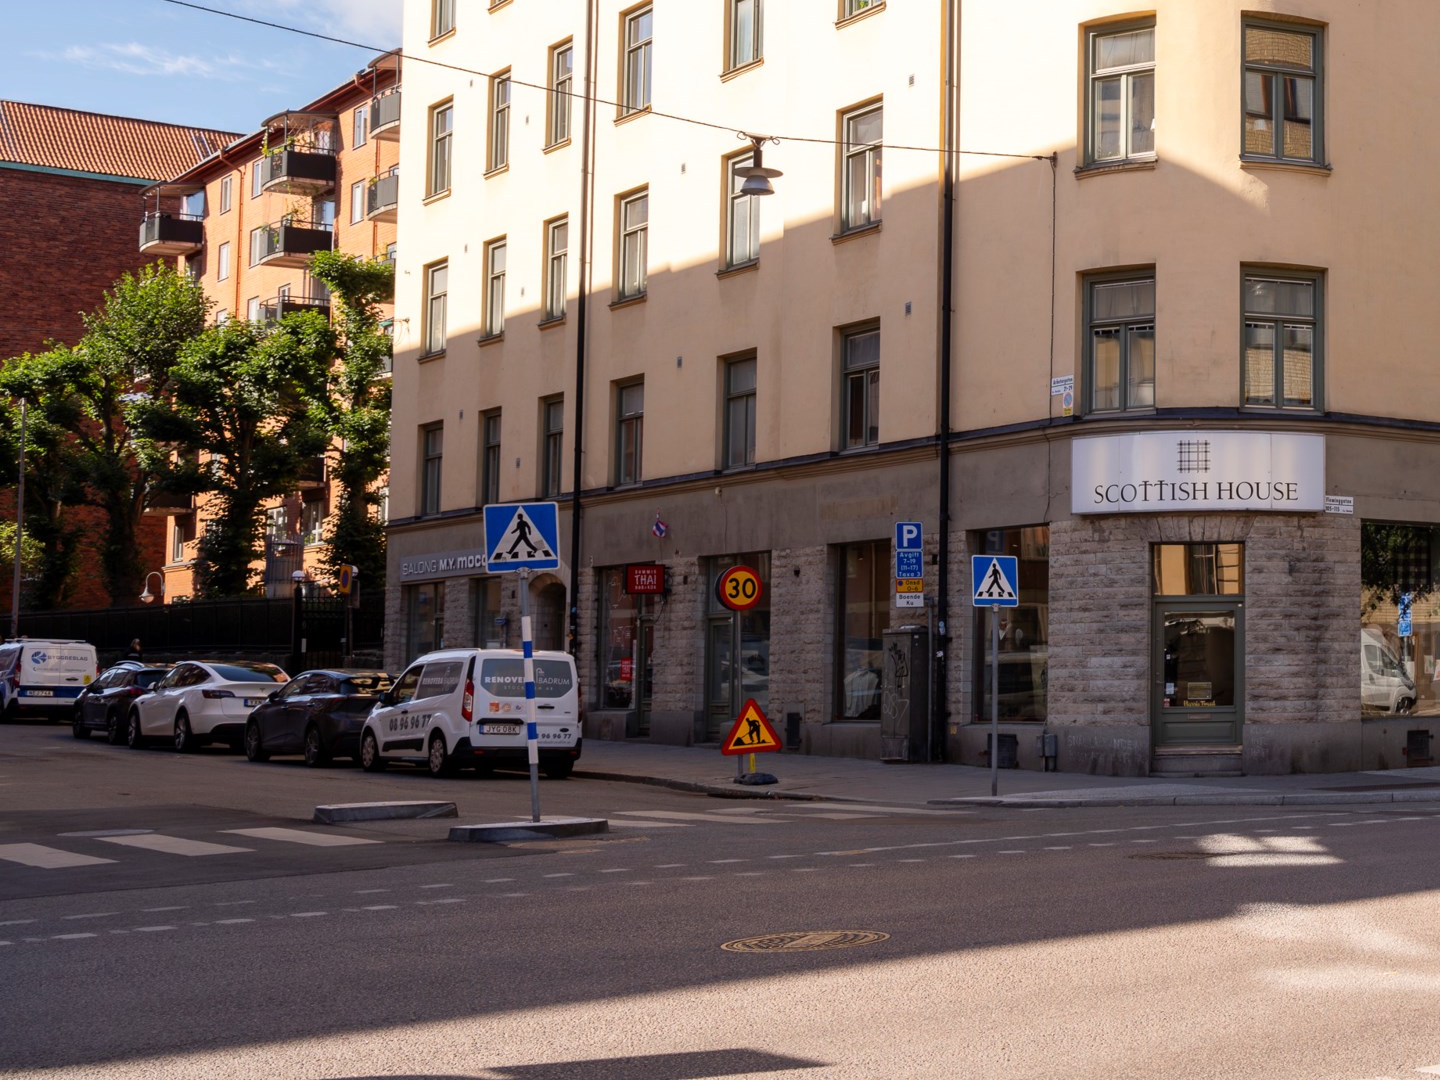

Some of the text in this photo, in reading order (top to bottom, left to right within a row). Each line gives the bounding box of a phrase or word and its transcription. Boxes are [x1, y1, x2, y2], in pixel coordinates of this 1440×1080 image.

[1094, 480, 1299, 504] SCOTTISH HOUSE
[903, 525, 918, 548] P
[402, 560, 437, 575] SALONG
[634, 574, 657, 585] THAI
[728, 577, 756, 599] 30
[484, 676, 570, 685] RENOVE BADRUM
